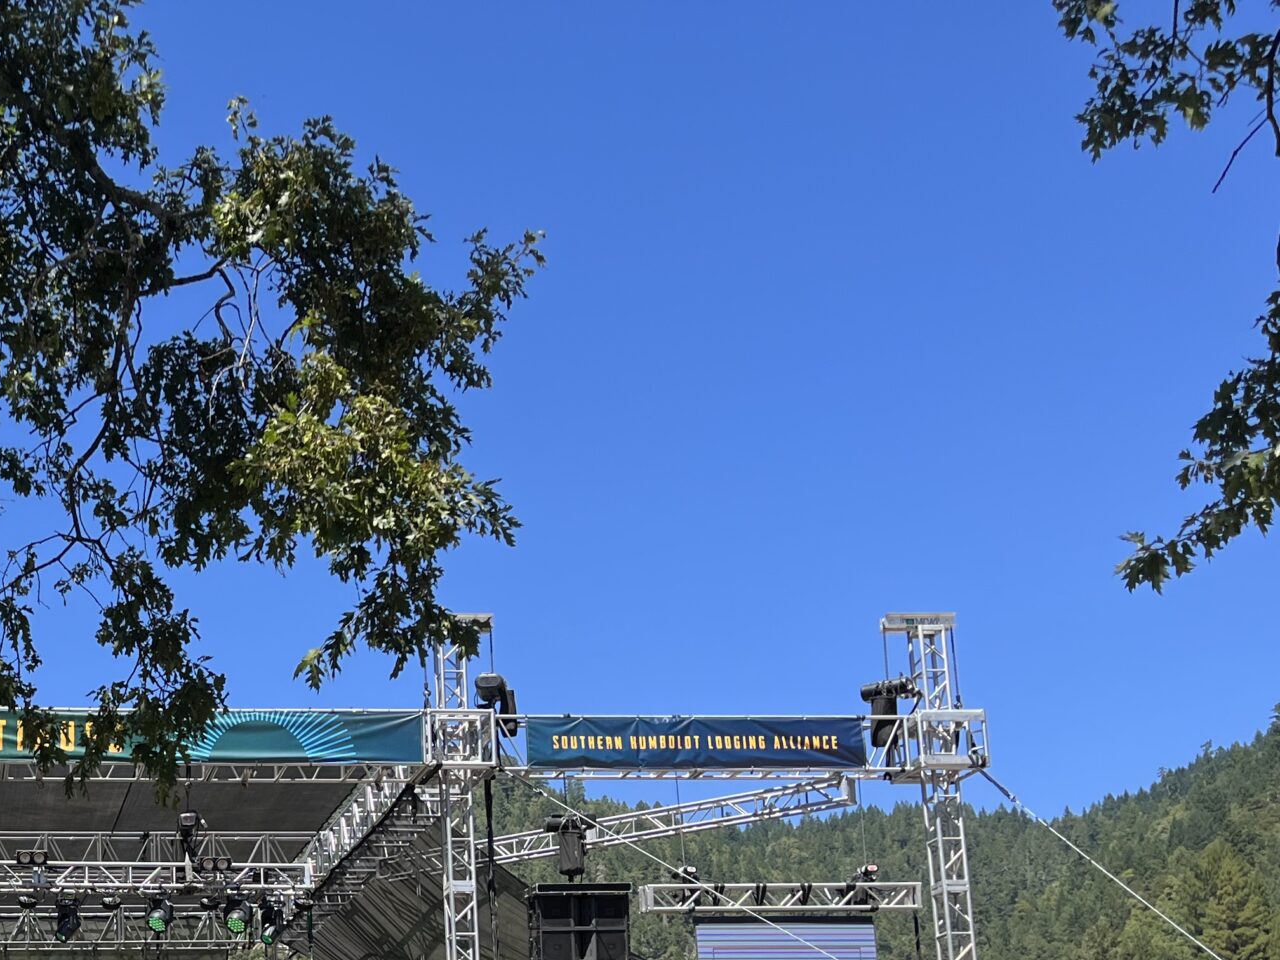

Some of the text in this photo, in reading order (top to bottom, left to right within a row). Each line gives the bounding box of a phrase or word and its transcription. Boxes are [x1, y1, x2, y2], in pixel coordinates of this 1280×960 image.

[552, 734, 839, 750] SOUTHERN HUMBOLDT LODGING ALLIANCE
